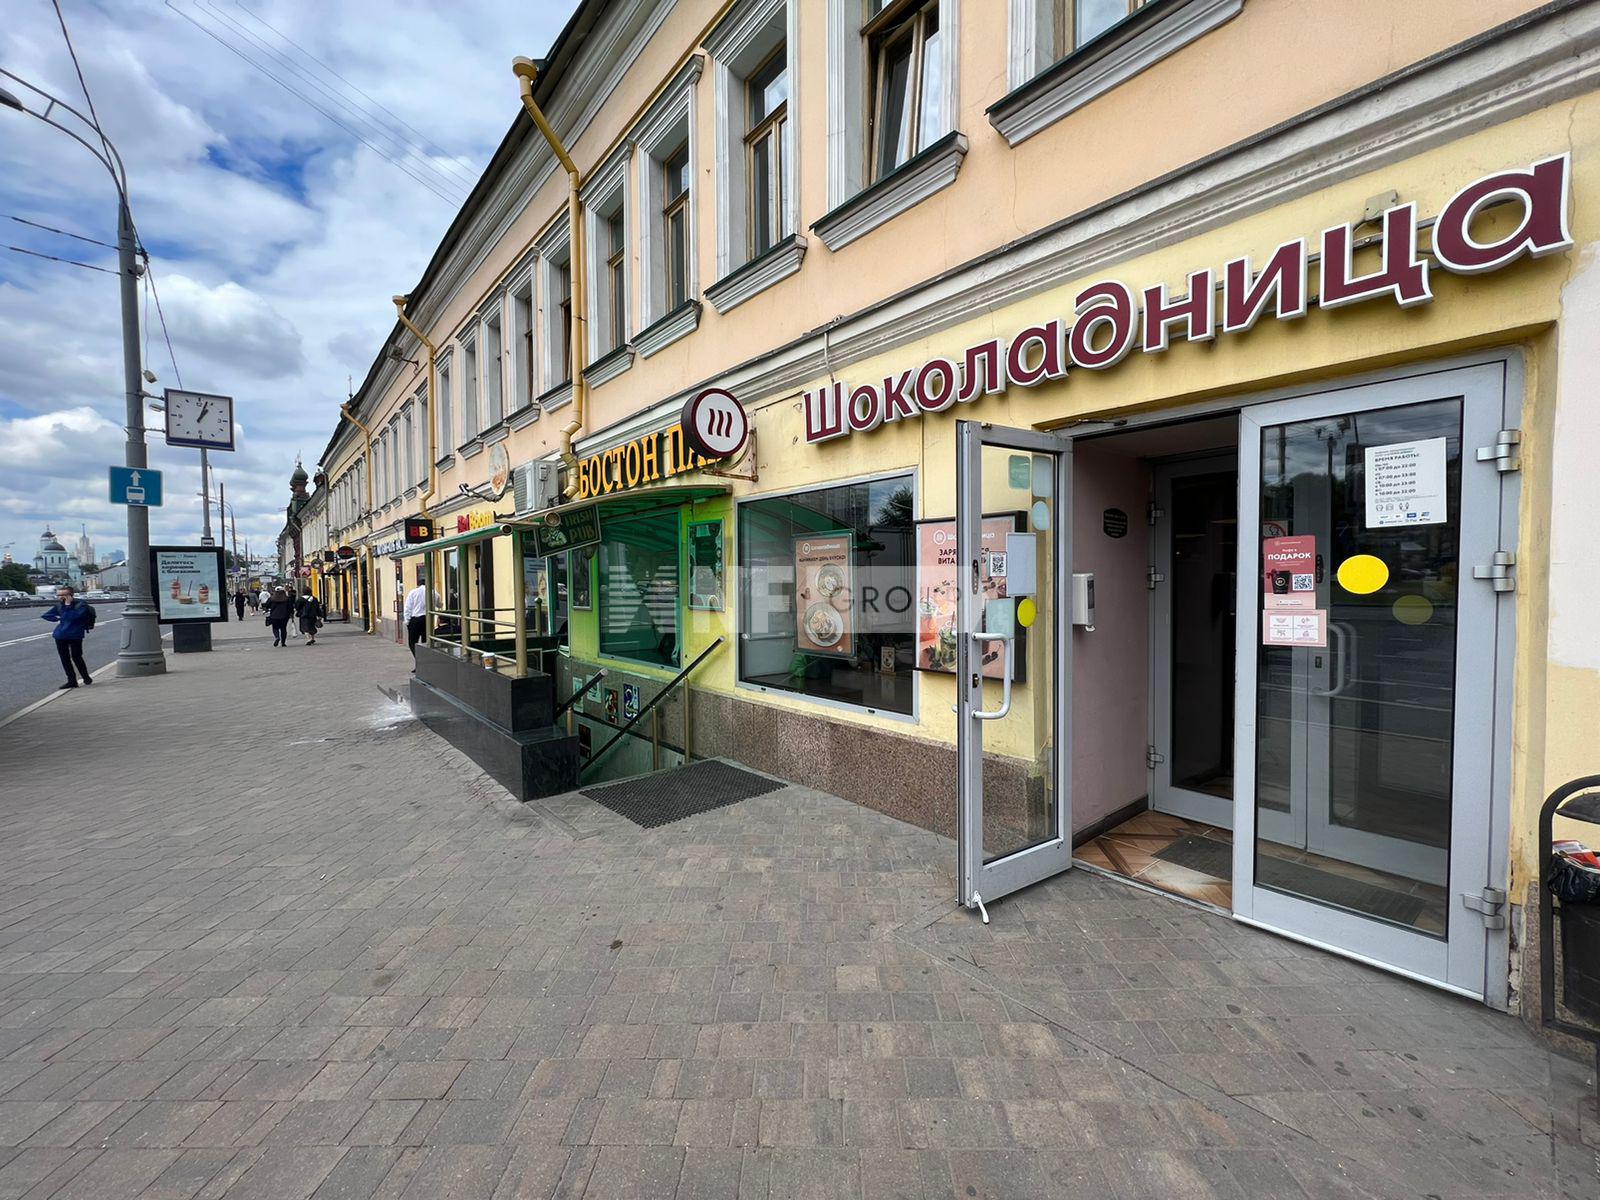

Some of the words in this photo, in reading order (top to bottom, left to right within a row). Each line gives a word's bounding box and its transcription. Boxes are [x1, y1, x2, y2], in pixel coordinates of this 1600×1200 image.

[802, 152, 1574, 444] Шоколадница
[579, 432, 660, 500] БОСТОН
[1268, 552, 1311, 560] ПОДАРОК
